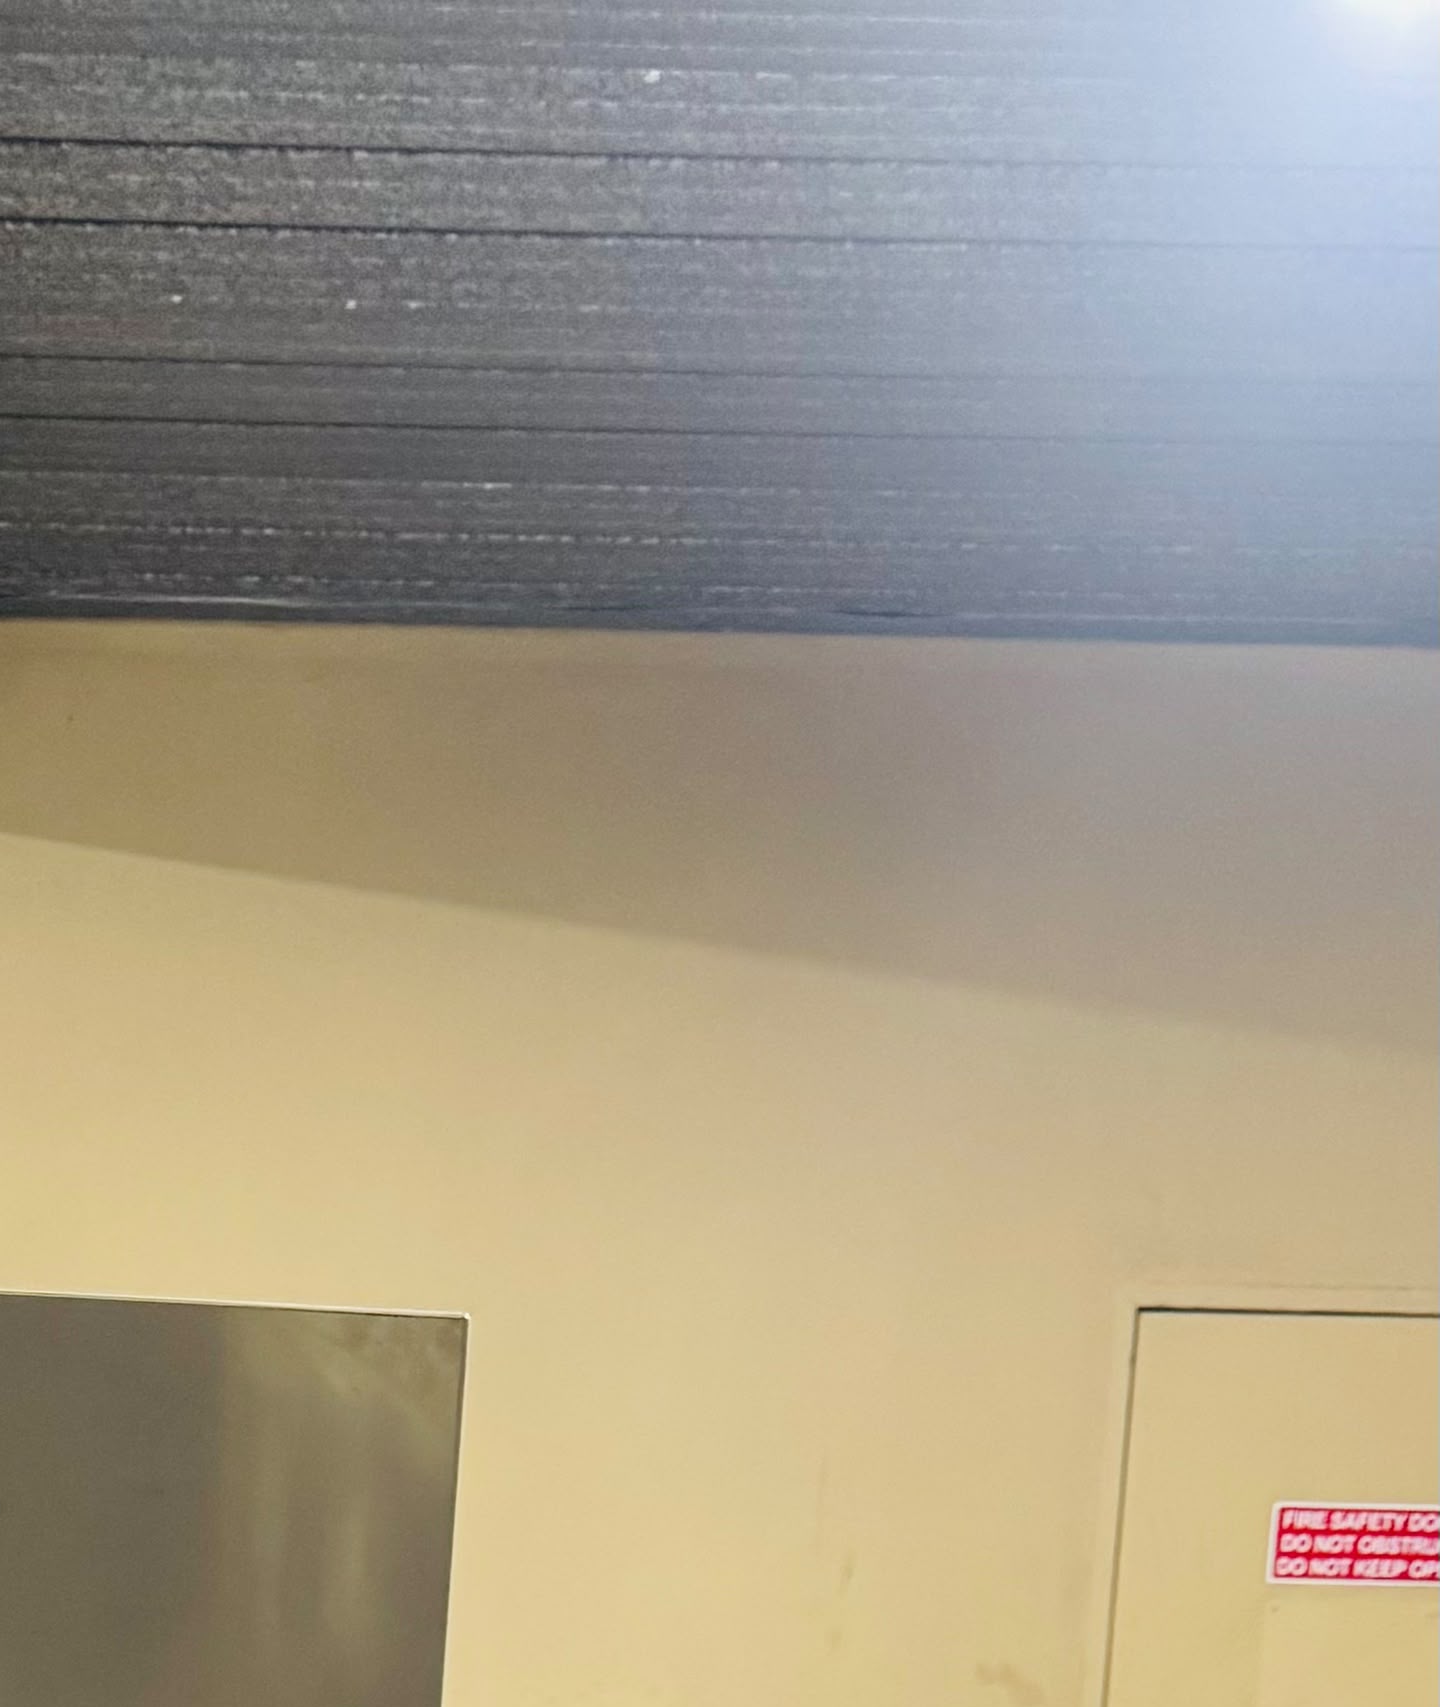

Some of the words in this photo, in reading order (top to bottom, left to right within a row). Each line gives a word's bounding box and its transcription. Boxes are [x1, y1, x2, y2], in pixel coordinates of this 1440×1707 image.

[1281, 1509, 1327, 1529] FIRE
[1329, 1511, 1408, 1532] SAFETY
[1280, 1533, 1313, 1553] DO
[1313, 1534, 1358, 1555] NOT
[1276, 1556, 1309, 1576] DO
[1308, 1557, 1353, 1577] NOT
[1352, 1559, 1409, 1578] KEEP
